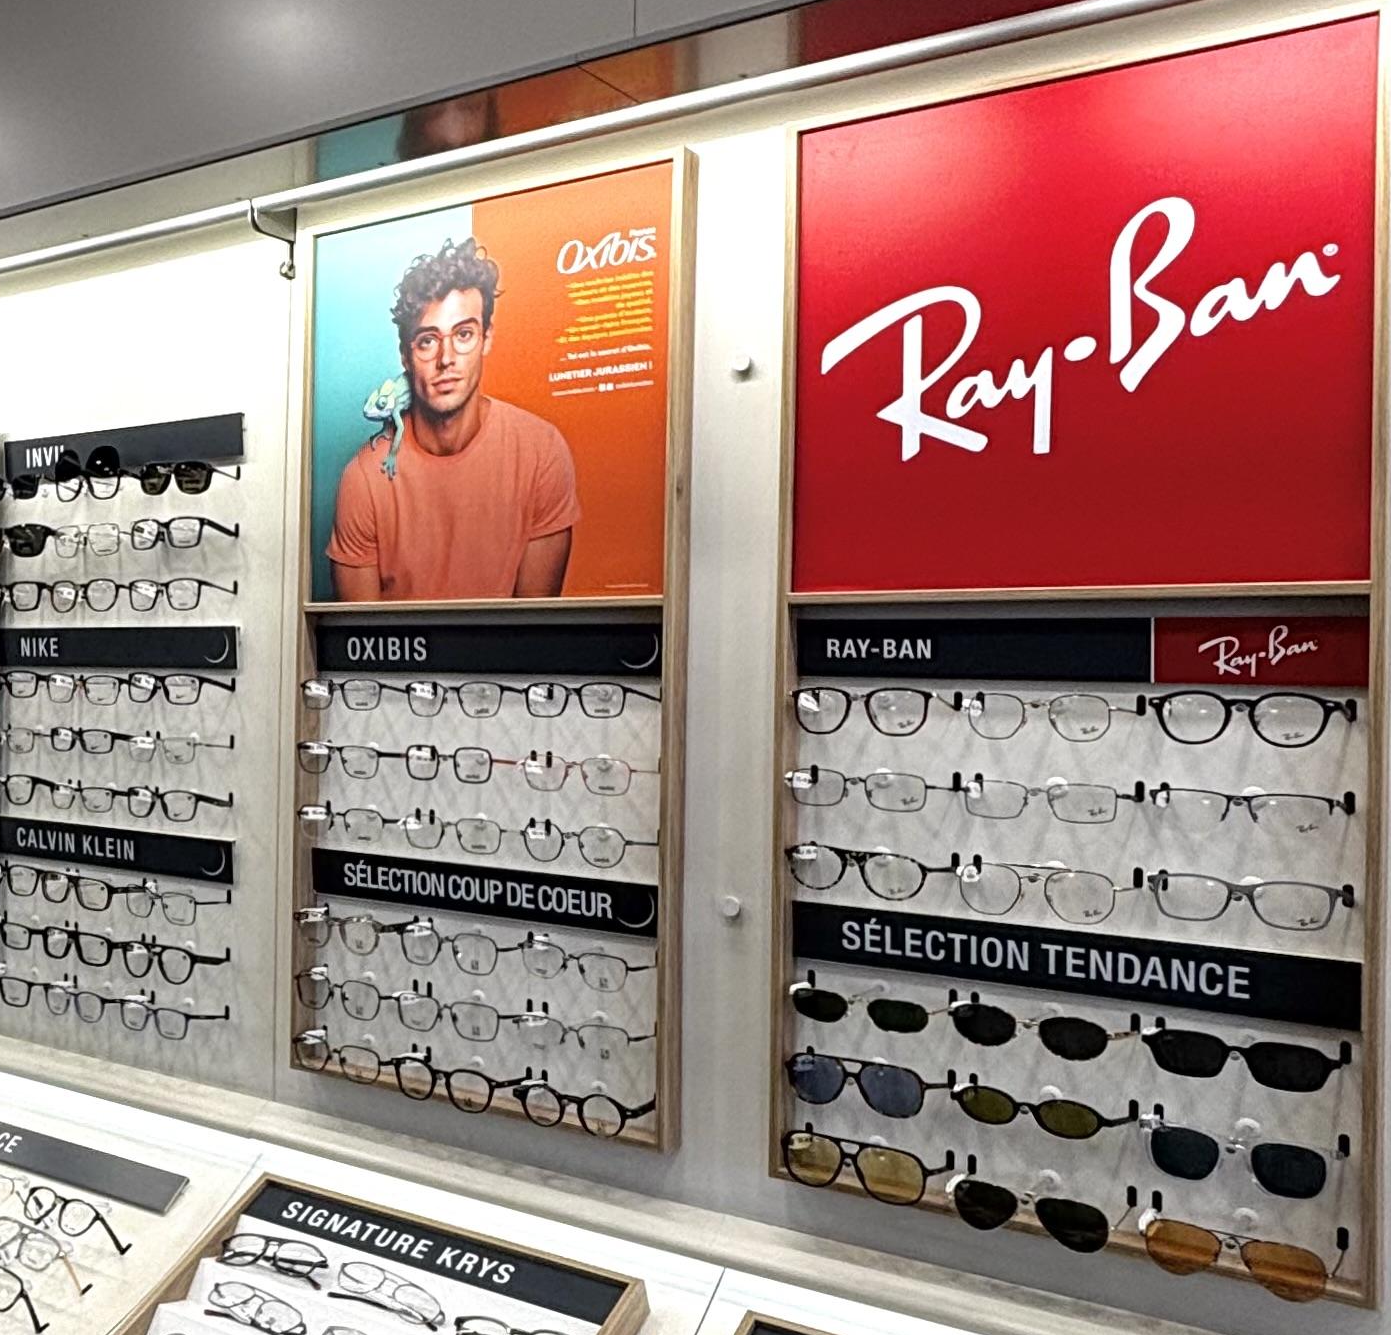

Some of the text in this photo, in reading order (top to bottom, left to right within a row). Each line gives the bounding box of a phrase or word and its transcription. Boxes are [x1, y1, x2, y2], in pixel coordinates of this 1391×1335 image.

[821, 196, 1341, 462] Ray-Ban
[20, 637, 59, 658] NIKE
[346, 636, 427, 662] OXIBIS
[826, 638, 932, 659] RAY-BAN
[1198, 624, 1319, 677] Ray-Ban
[16, 827, 135, 861] CALVIN KLEIN
[343, 860, 613, 920] SÉLECTION COUP DE COEUR
[840, 917, 1252, 1001] SÉLECTION TENDANCE
[281, 1200, 517, 1286] SIGNATURE KRYS
